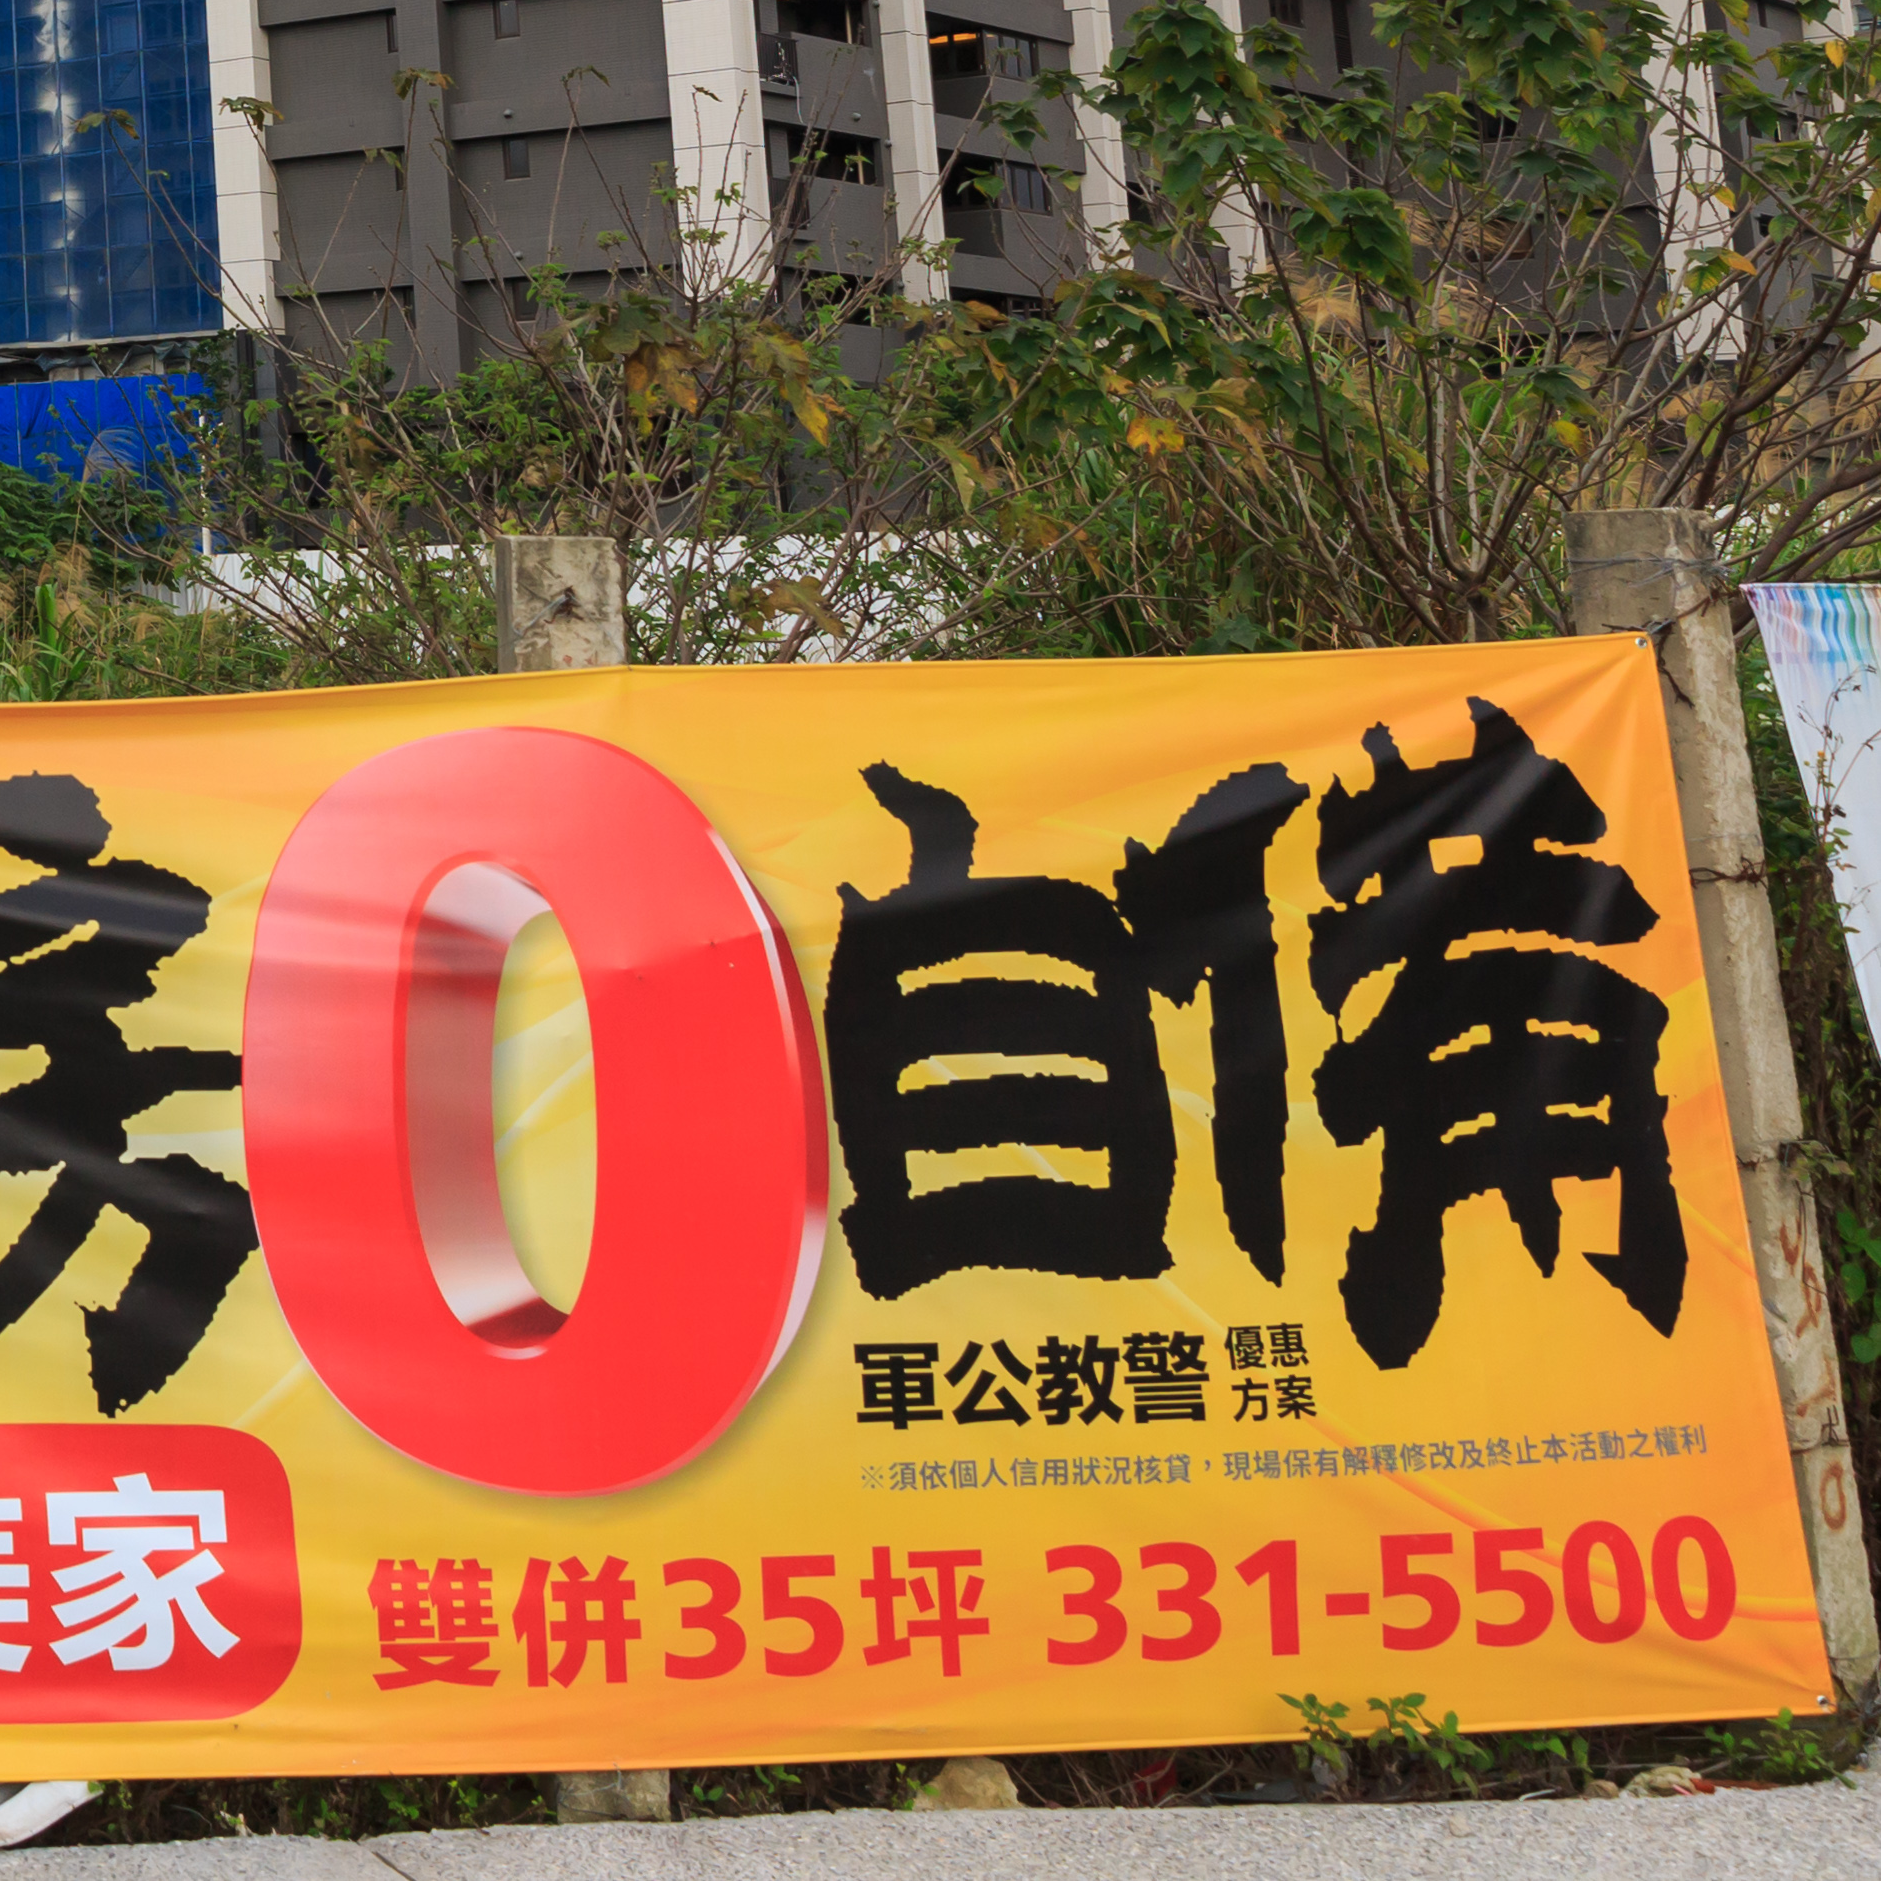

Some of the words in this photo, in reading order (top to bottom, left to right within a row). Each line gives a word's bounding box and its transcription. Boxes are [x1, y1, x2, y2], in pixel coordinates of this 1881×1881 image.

[853, 1332, 1211, 1430] 軍公教警
[1224, 1322, 1310, 1371] 優惠
[1231, 1374, 1318, 1422] 方案
[368, 1548, 991, 1691] 雙併35坪
[1045, 1514, 1738, 1666] 331-5500
